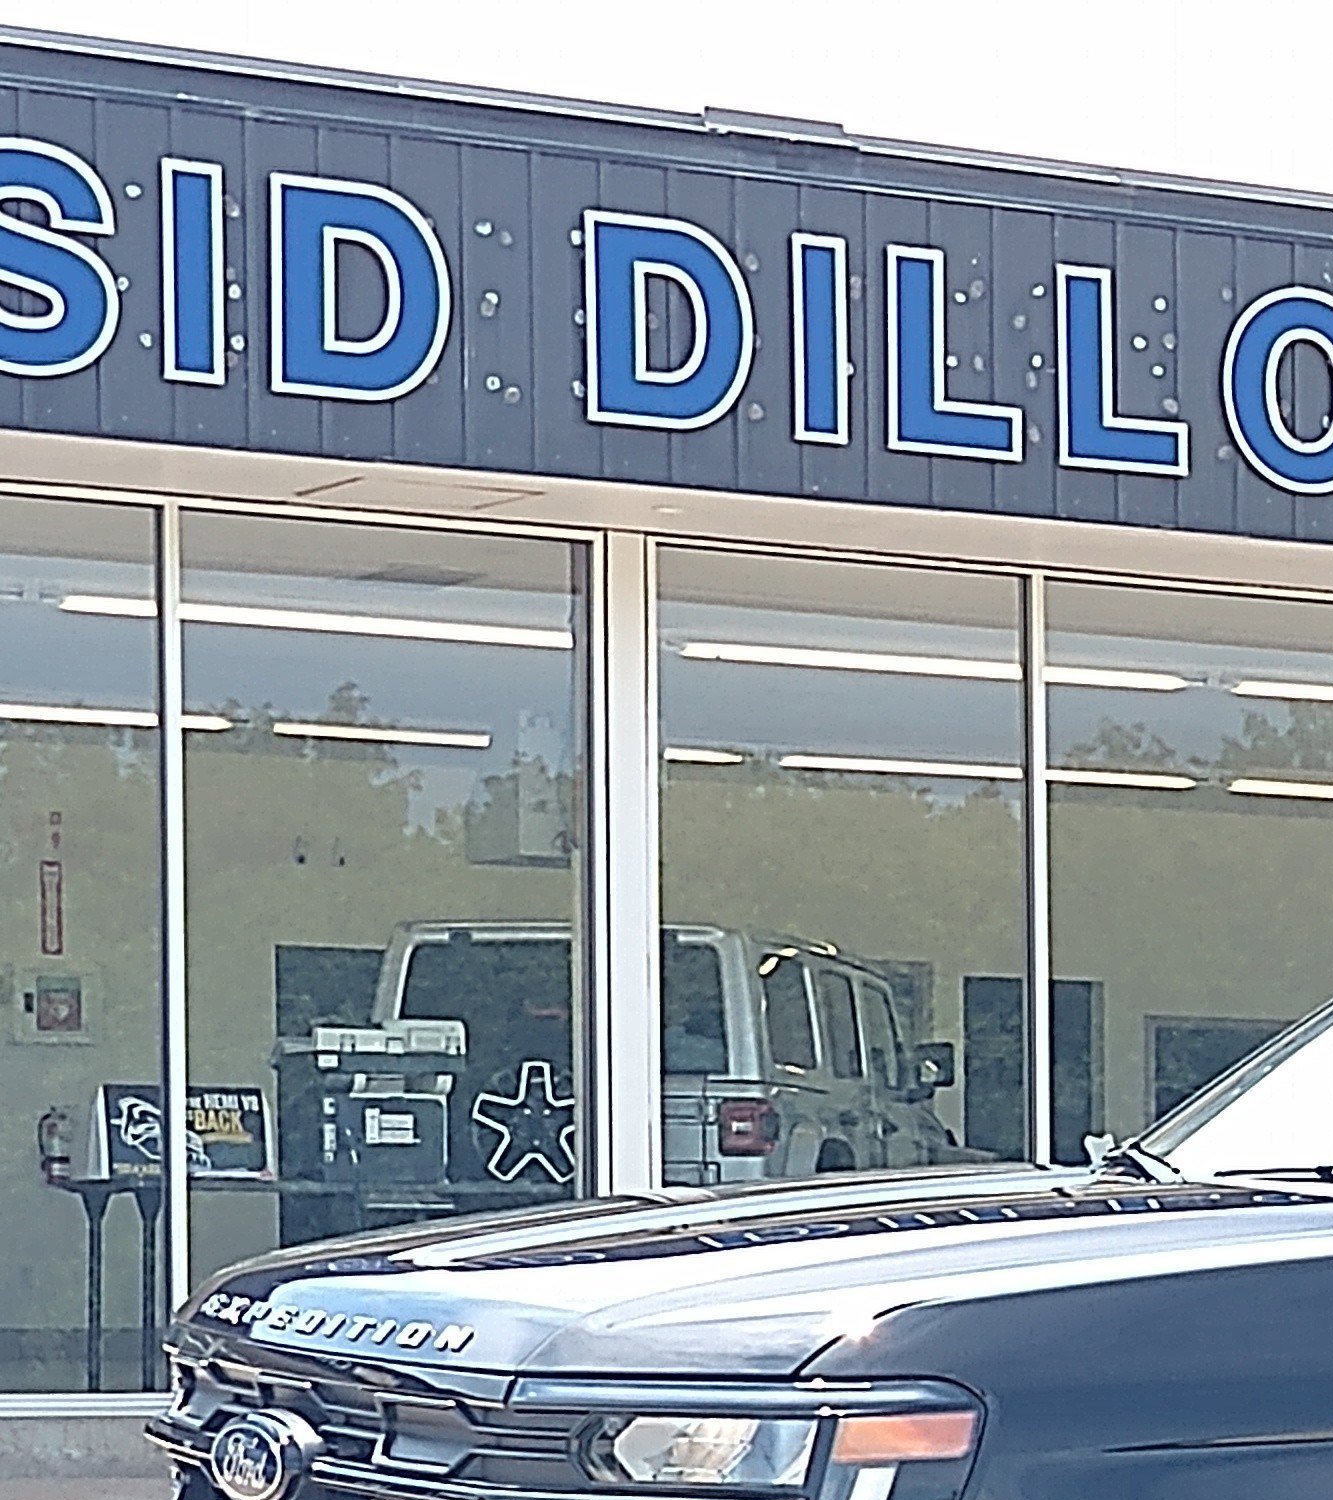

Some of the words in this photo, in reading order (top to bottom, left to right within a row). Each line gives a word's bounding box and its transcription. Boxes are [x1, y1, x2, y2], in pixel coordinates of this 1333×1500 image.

[0, 136, 452, 403] SID
[194, 1109, 244, 1132] BACK
[200, 1293, 477, 1353] EXPEDITION
